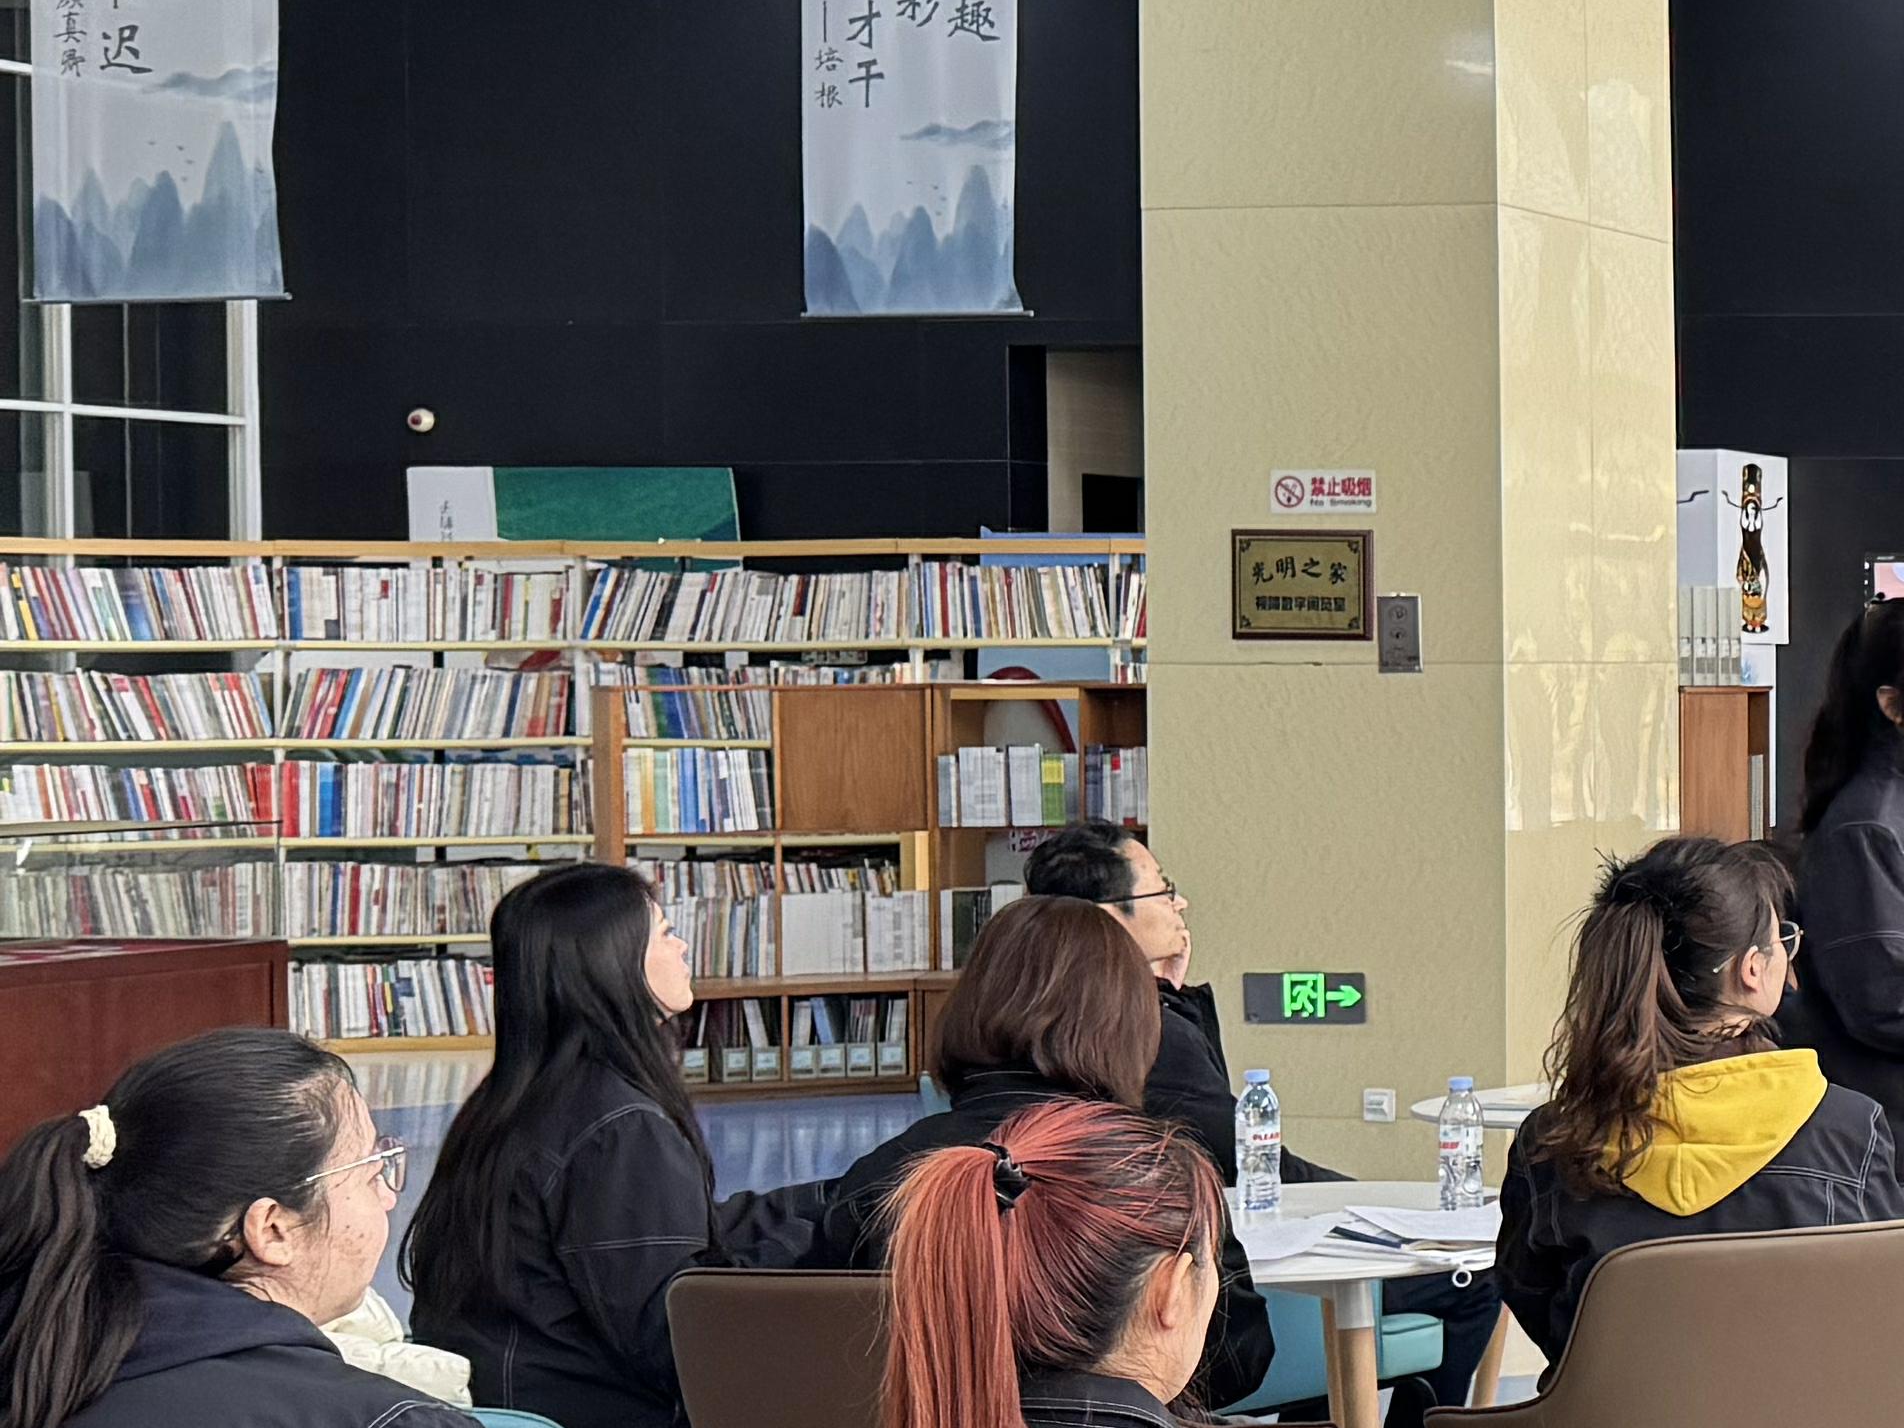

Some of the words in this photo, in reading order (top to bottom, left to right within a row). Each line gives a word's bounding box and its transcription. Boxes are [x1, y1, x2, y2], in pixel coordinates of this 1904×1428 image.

[1311, 476, 1372, 497] 禁止吸烟
[1252, 555, 1348, 586] 光明之家
